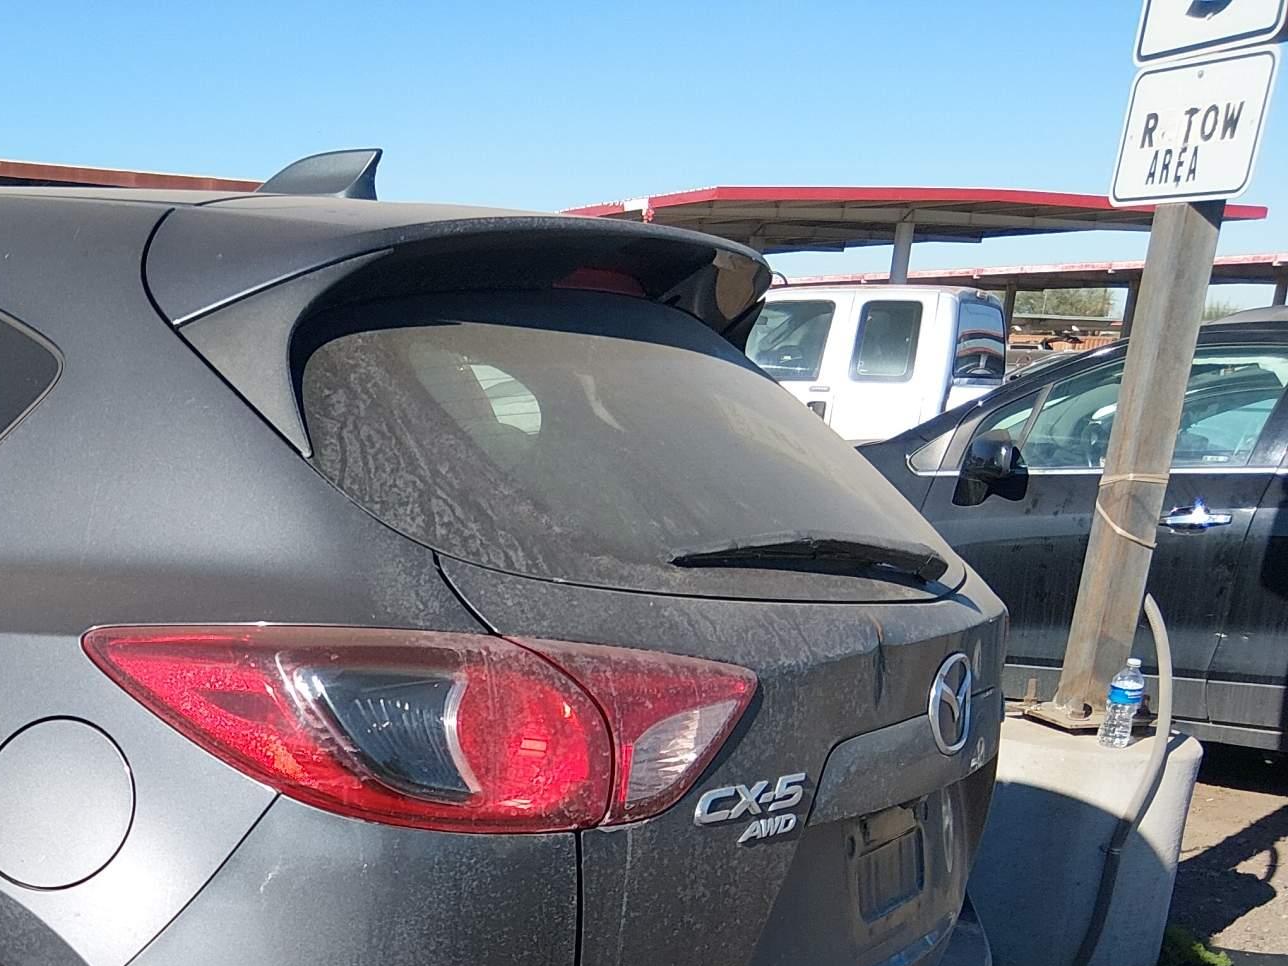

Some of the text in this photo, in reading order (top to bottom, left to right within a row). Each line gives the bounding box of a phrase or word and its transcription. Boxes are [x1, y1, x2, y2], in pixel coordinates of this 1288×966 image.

[1184, 101, 1245, 143] TOW
[1145, 146, 1199, 185] AREA
[694, 772, 806, 825] CX-5
[737, 813, 797, 844] AWD
